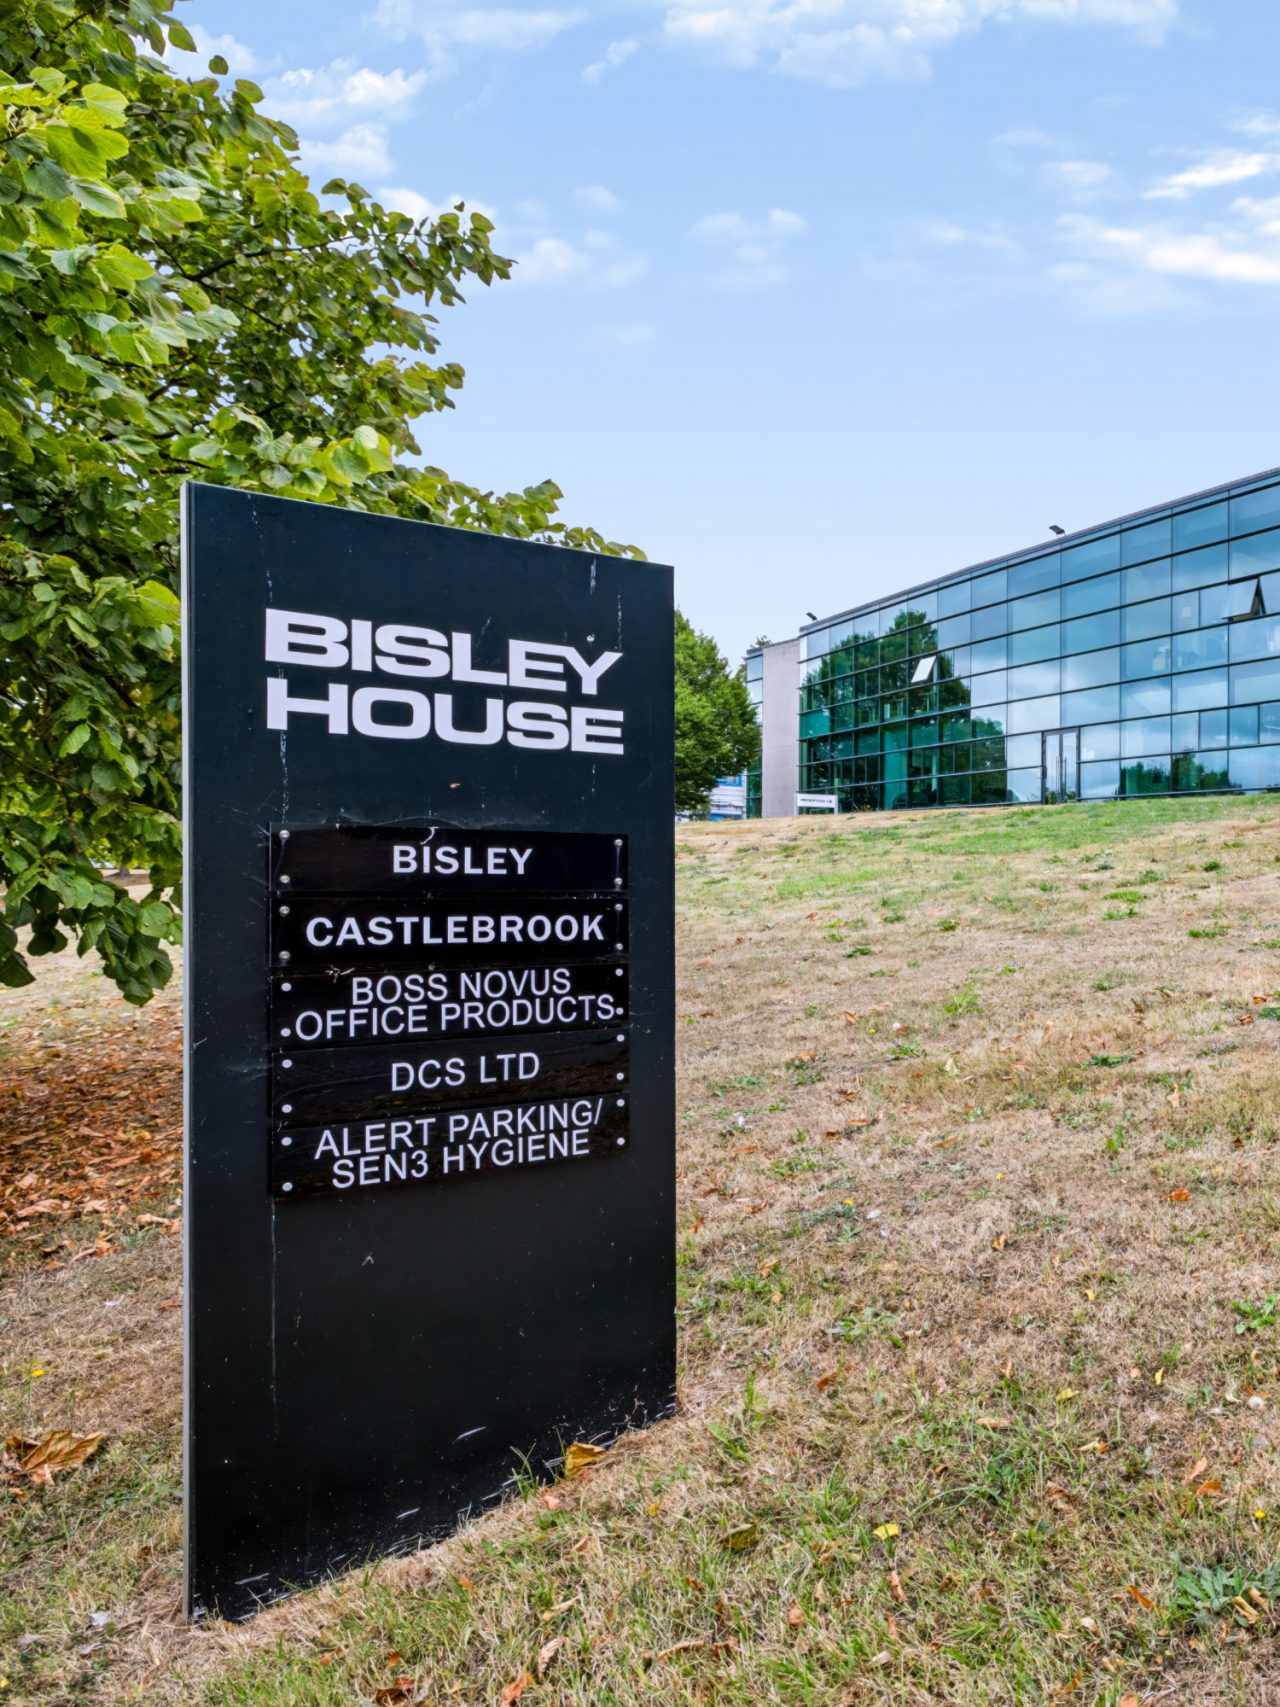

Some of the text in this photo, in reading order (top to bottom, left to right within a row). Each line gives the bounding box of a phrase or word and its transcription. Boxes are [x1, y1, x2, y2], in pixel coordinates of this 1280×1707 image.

[264, 608, 624, 696] BISLEY
[266, 677, 624, 755] HOUSE
[392, 845, 533, 875] BISLEY
[305, 914, 605, 947] CASTLEBROOK
[352, 967, 571, 1006] BOSS NOVUS
[295, 993, 615, 1041] OFFICE PRODUCTS
[391, 1051, 540, 1092] DCS LTD
[314, 1097, 603, 1160] ALERT PARKING/
[332, 1128, 590, 1189] SEN3 HYGIENE
